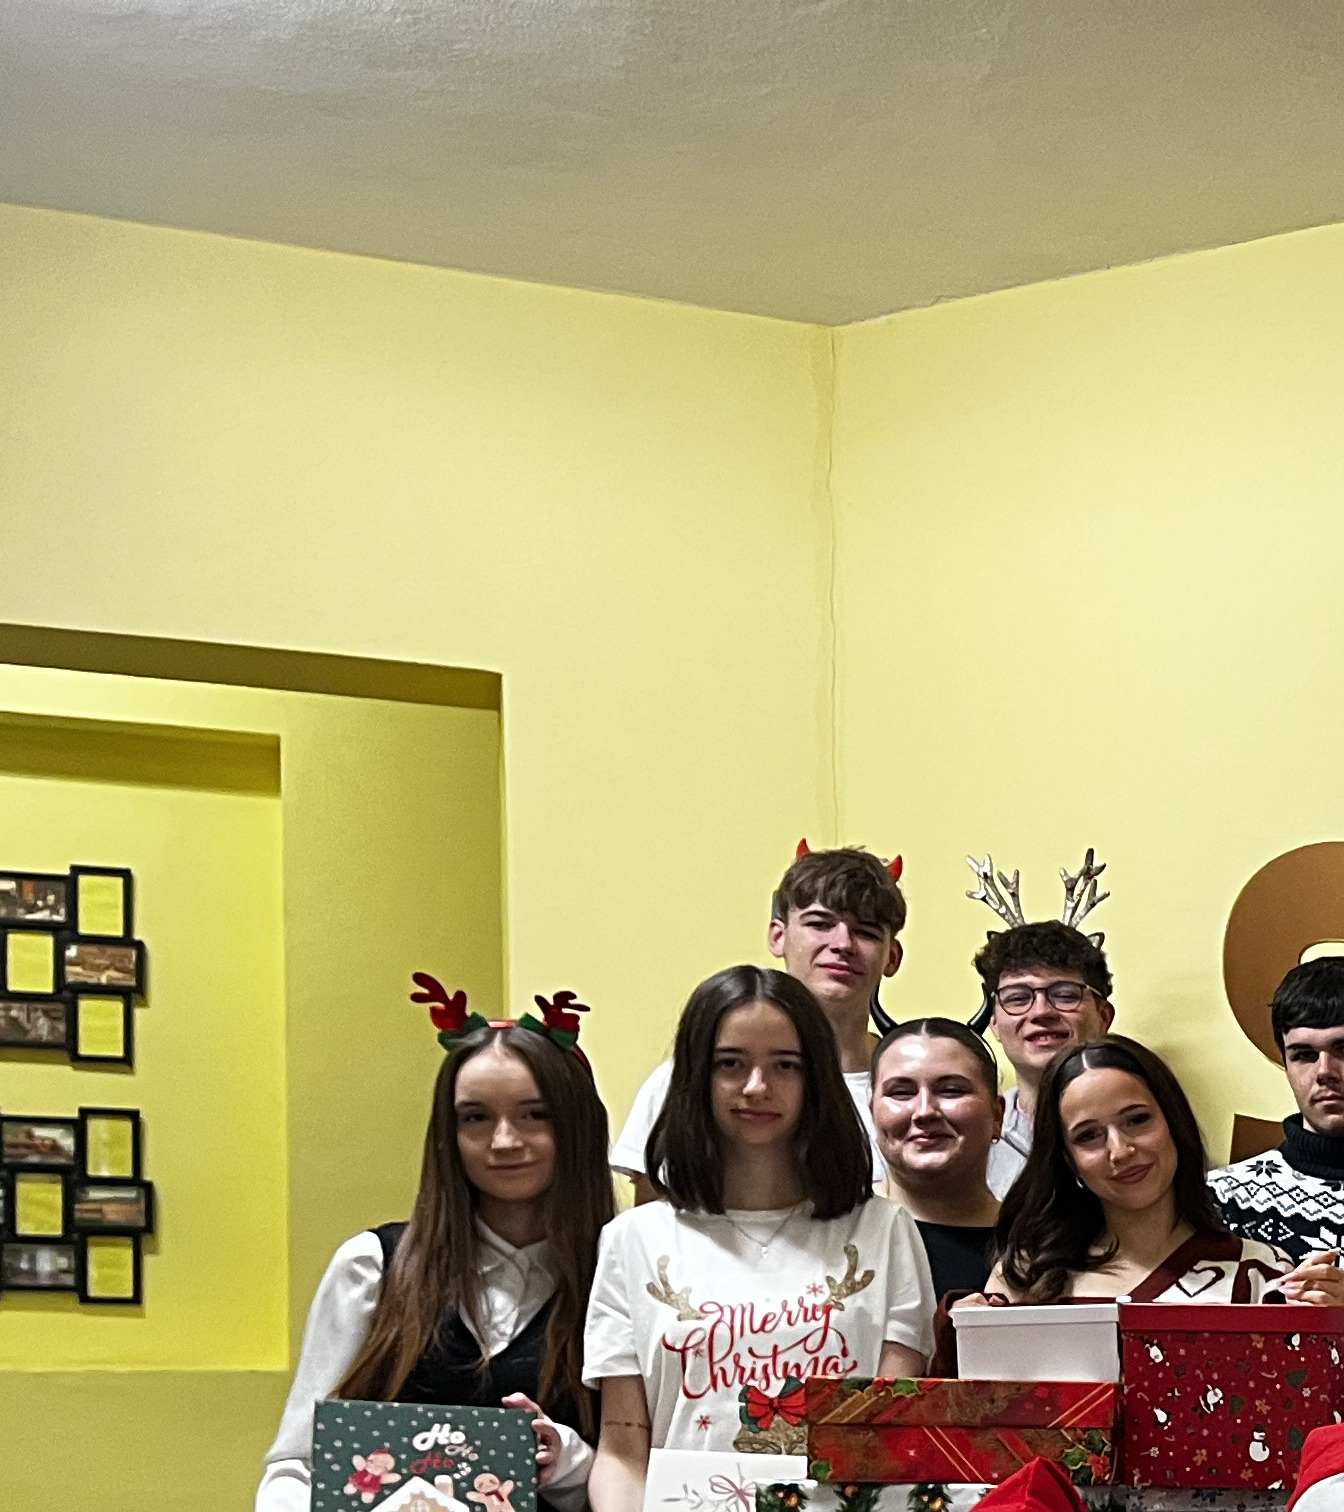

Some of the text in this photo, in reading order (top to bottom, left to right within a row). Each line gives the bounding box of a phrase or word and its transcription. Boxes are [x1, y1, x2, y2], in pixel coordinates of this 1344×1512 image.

[699, 1296, 848, 1356] Merry
[662, 1321, 858, 1400] Christma
[412, 1423, 466, 1452] Ho
[444, 1443, 479, 1461] Ho
[408, 1451, 456, 1475] Ho
